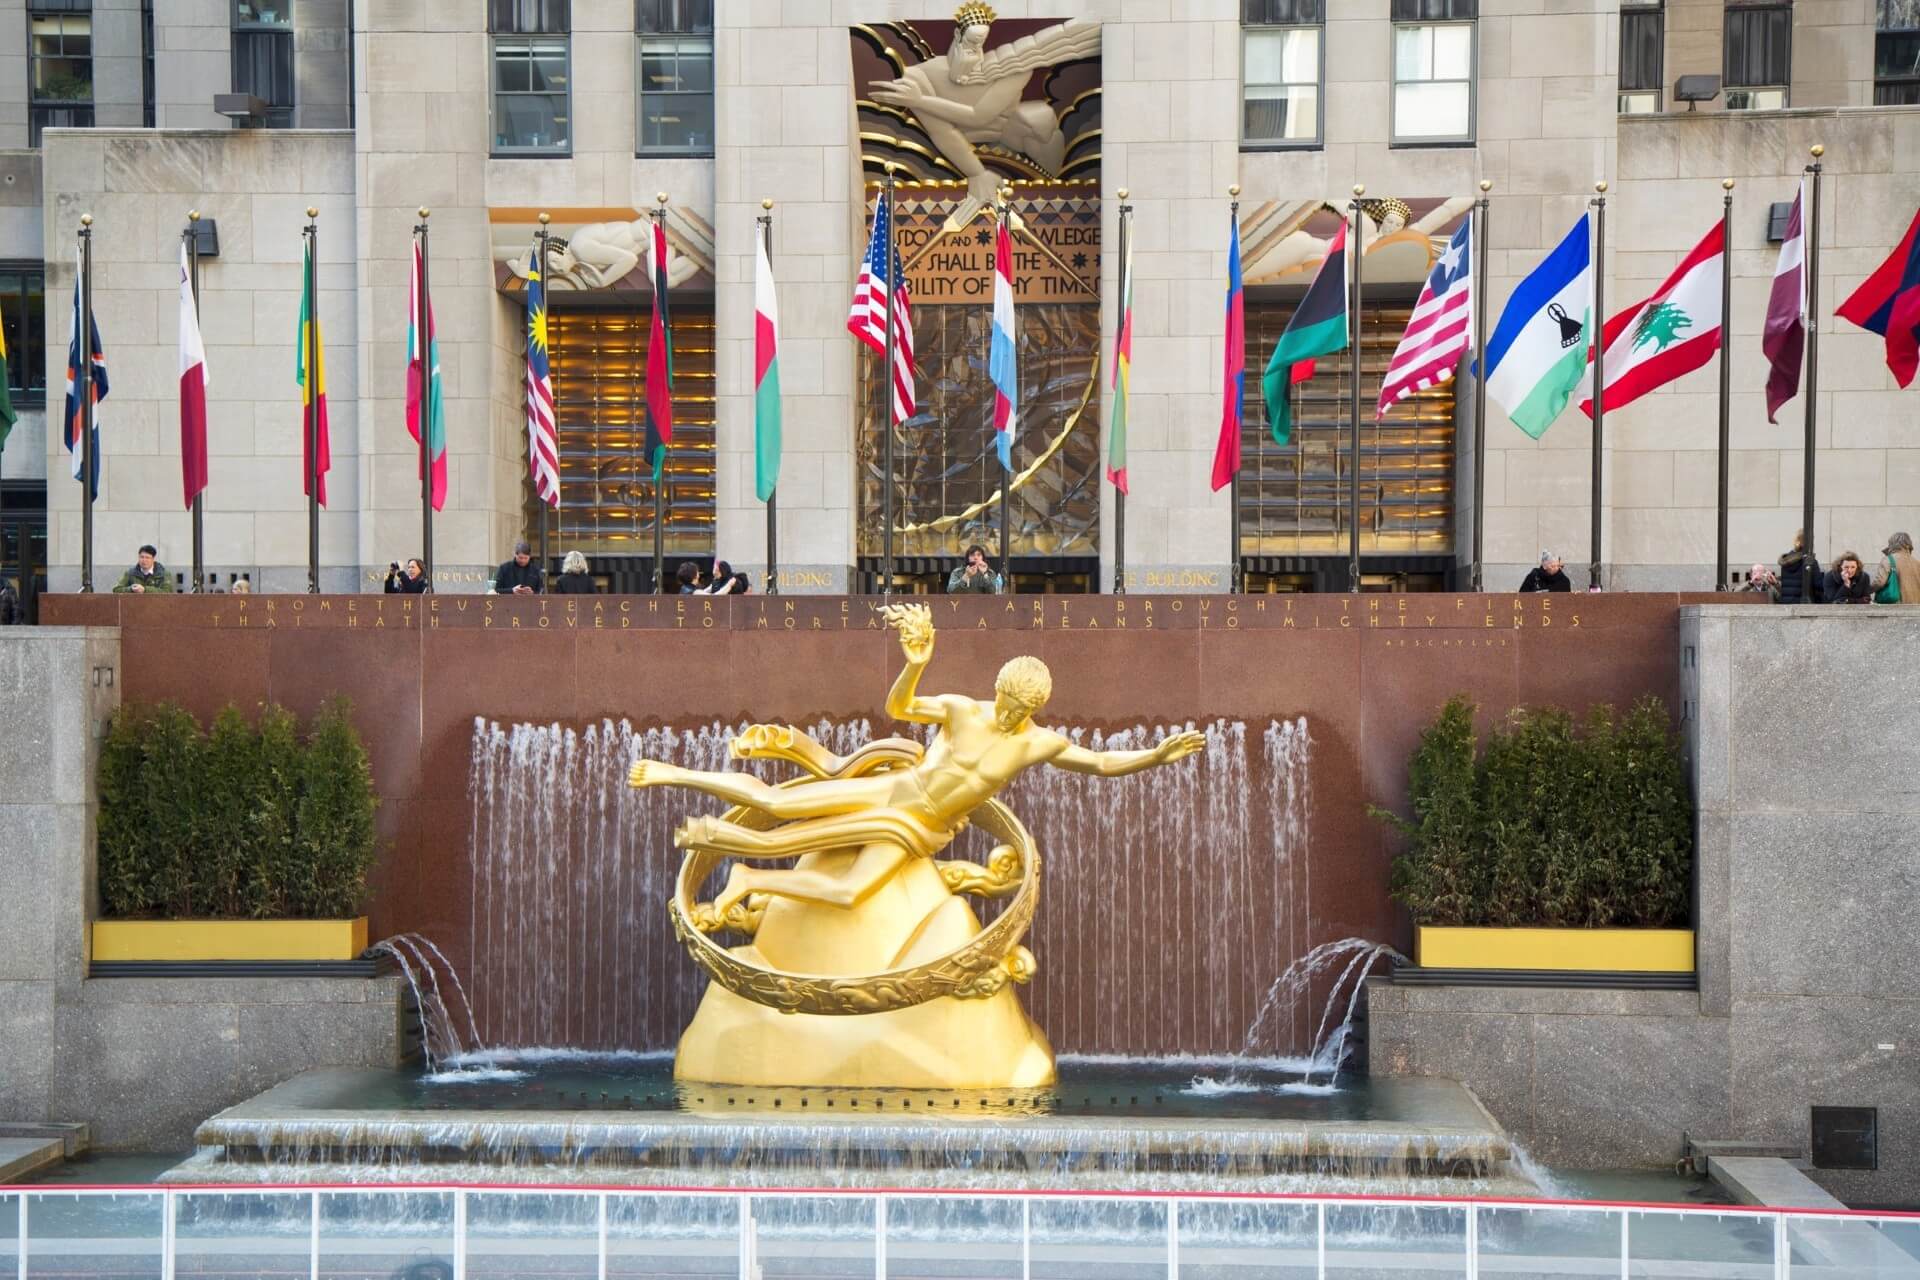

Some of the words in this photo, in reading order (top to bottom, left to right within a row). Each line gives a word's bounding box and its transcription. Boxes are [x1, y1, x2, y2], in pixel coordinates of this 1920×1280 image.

[950, 236, 971, 246] AND
[927, 253, 980, 271] SHALL
[1013, 253, 1041, 271] THE
[963, 277, 990, 295] OF
[1011, 277, 1033, 295] HY
[540, 600, 712, 612] TEACHER
[761, 601, 795, 612] IN
[841, 600, 959, 612] EVY
[1005, 600, 1070, 612] ART
[1342, 599, 1407, 610] THE
[1457, 599, 1551, 610] FIRE
[213, 616, 303, 627] THAT
[349, 616, 439, 627] HATH
[485, 616, 630, 627] PROVED
[676, 616, 713, 628] TO
[977, 617, 987, 628] A
[1032, 616, 1152, 628] MEANS
[1200, 616, 1238, 627] TO
[1283, 616, 1436, 627] MIGHTY
[1486, 616, 1580, 627] ENDS
